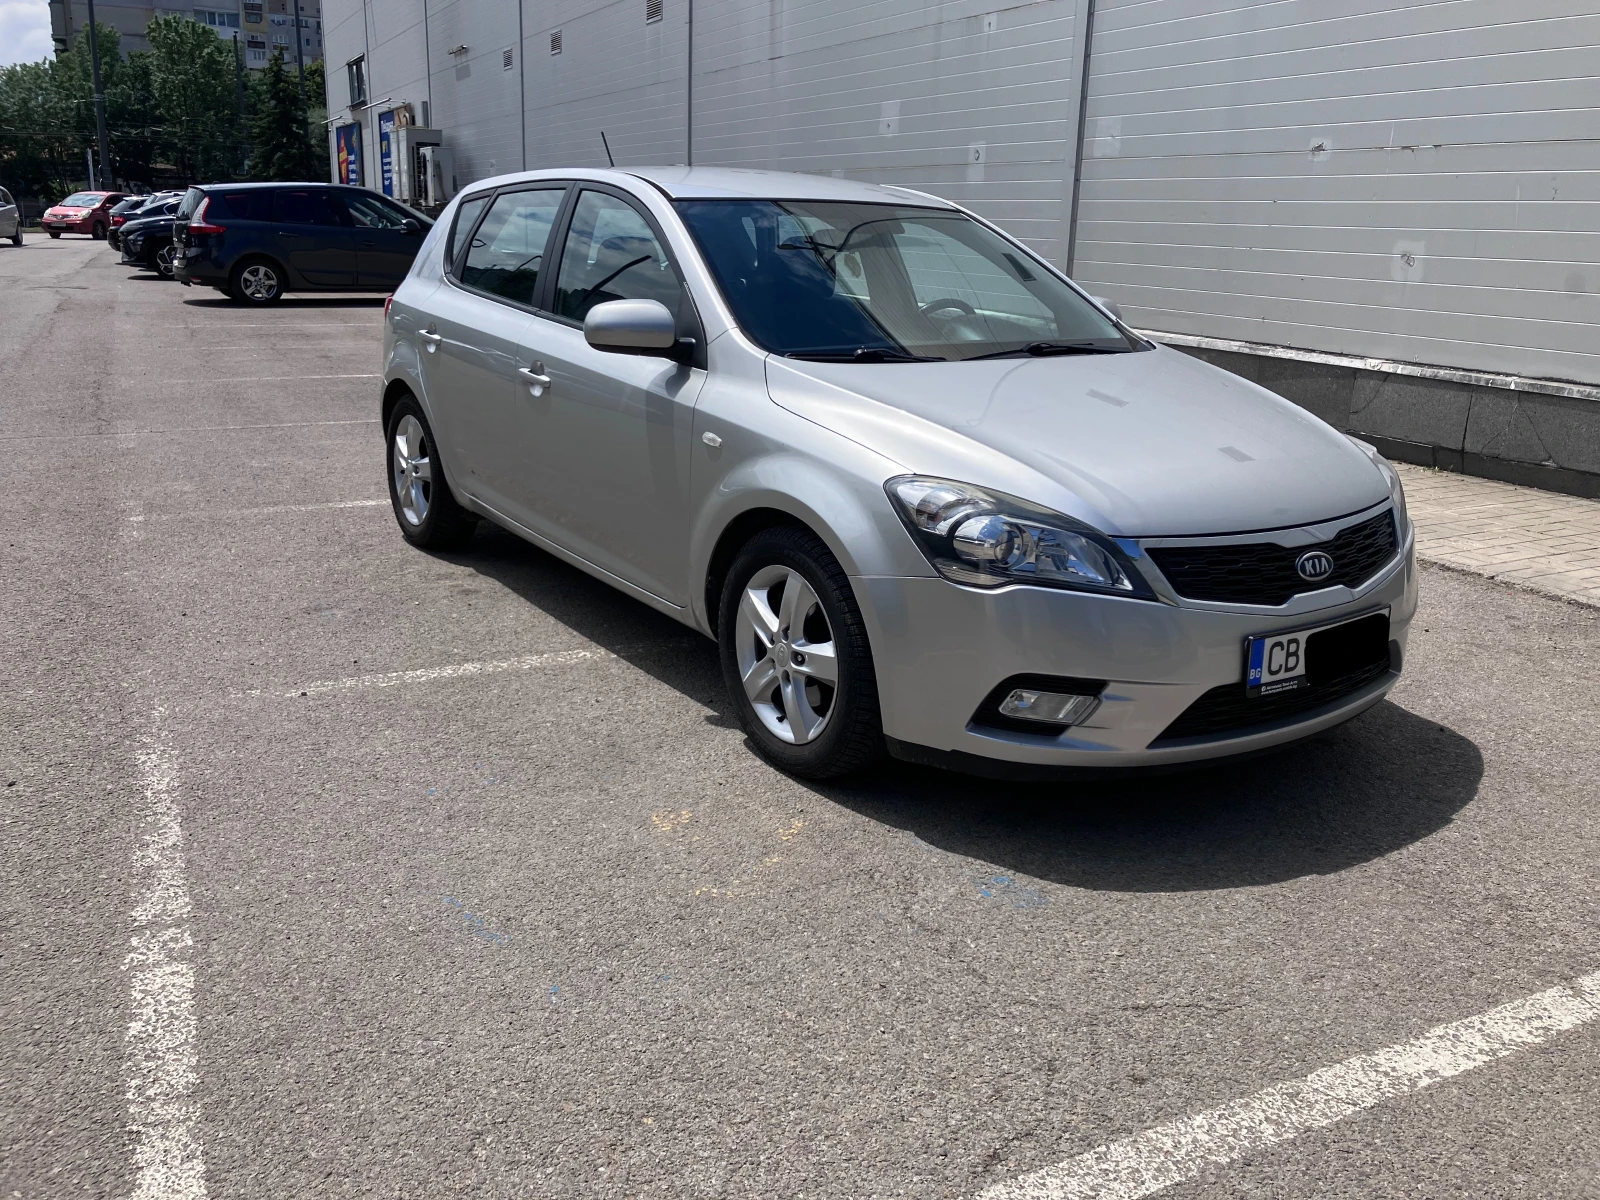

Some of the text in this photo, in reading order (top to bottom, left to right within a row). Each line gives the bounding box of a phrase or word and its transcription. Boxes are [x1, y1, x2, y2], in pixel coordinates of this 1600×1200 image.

[1304, 557, 1329, 575] KIA
[1267, 637, 1300, 676] CB
[1250, 668, 1262, 680] BG
